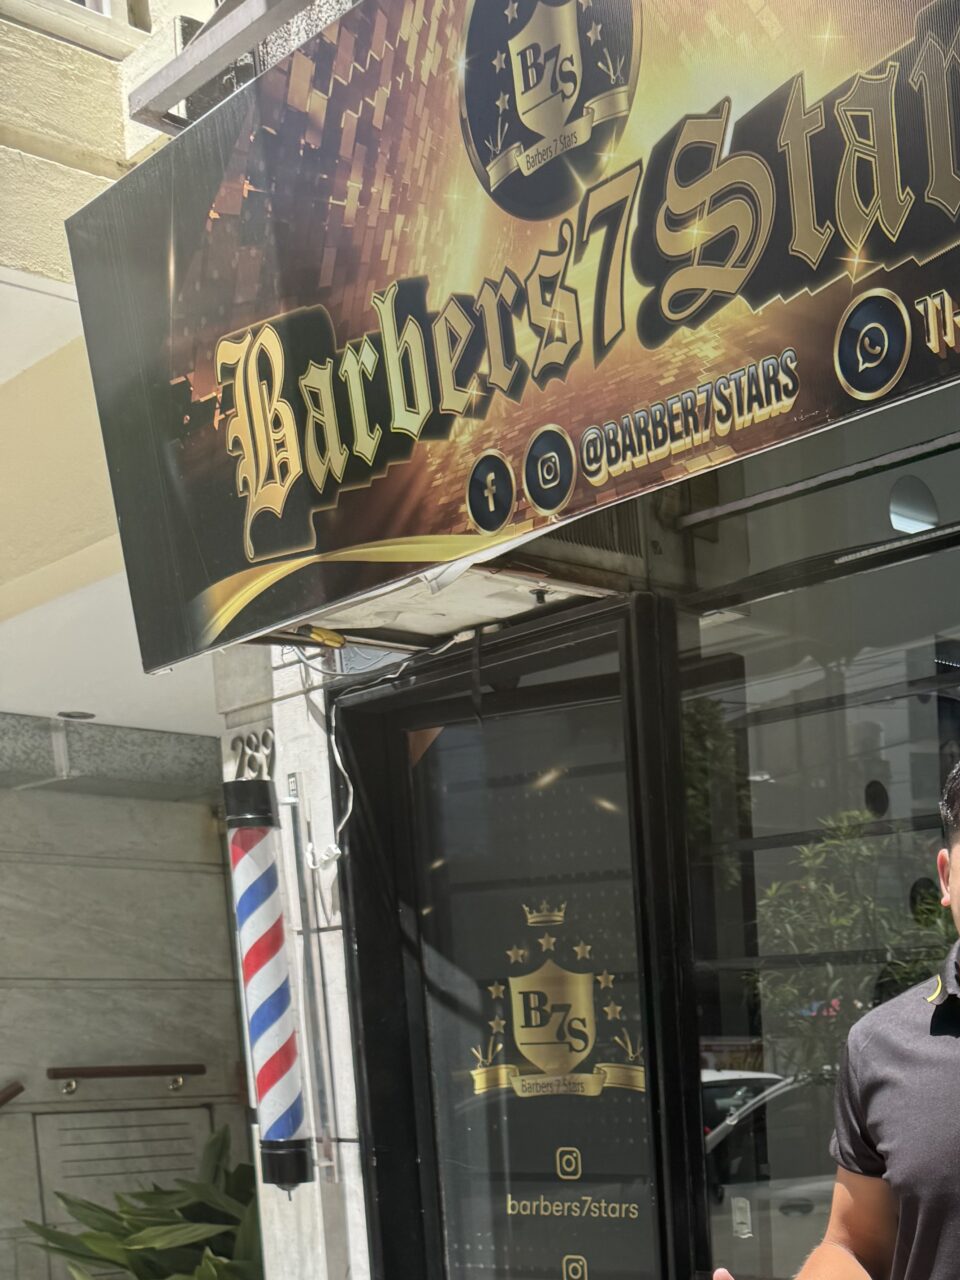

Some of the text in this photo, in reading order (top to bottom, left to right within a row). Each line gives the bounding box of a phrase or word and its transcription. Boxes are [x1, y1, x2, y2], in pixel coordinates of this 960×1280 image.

[525, 131, 578, 171] Barbers 7 Stars
[580, 346, 799, 484] @BARBER7STARS
[518, 991, 590, 1053] B7S
[521, 1079, 553, 1093] Barbers
[562, 1080, 585, 1093] Stars
[506, 1193, 640, 1219] barbers7stars
